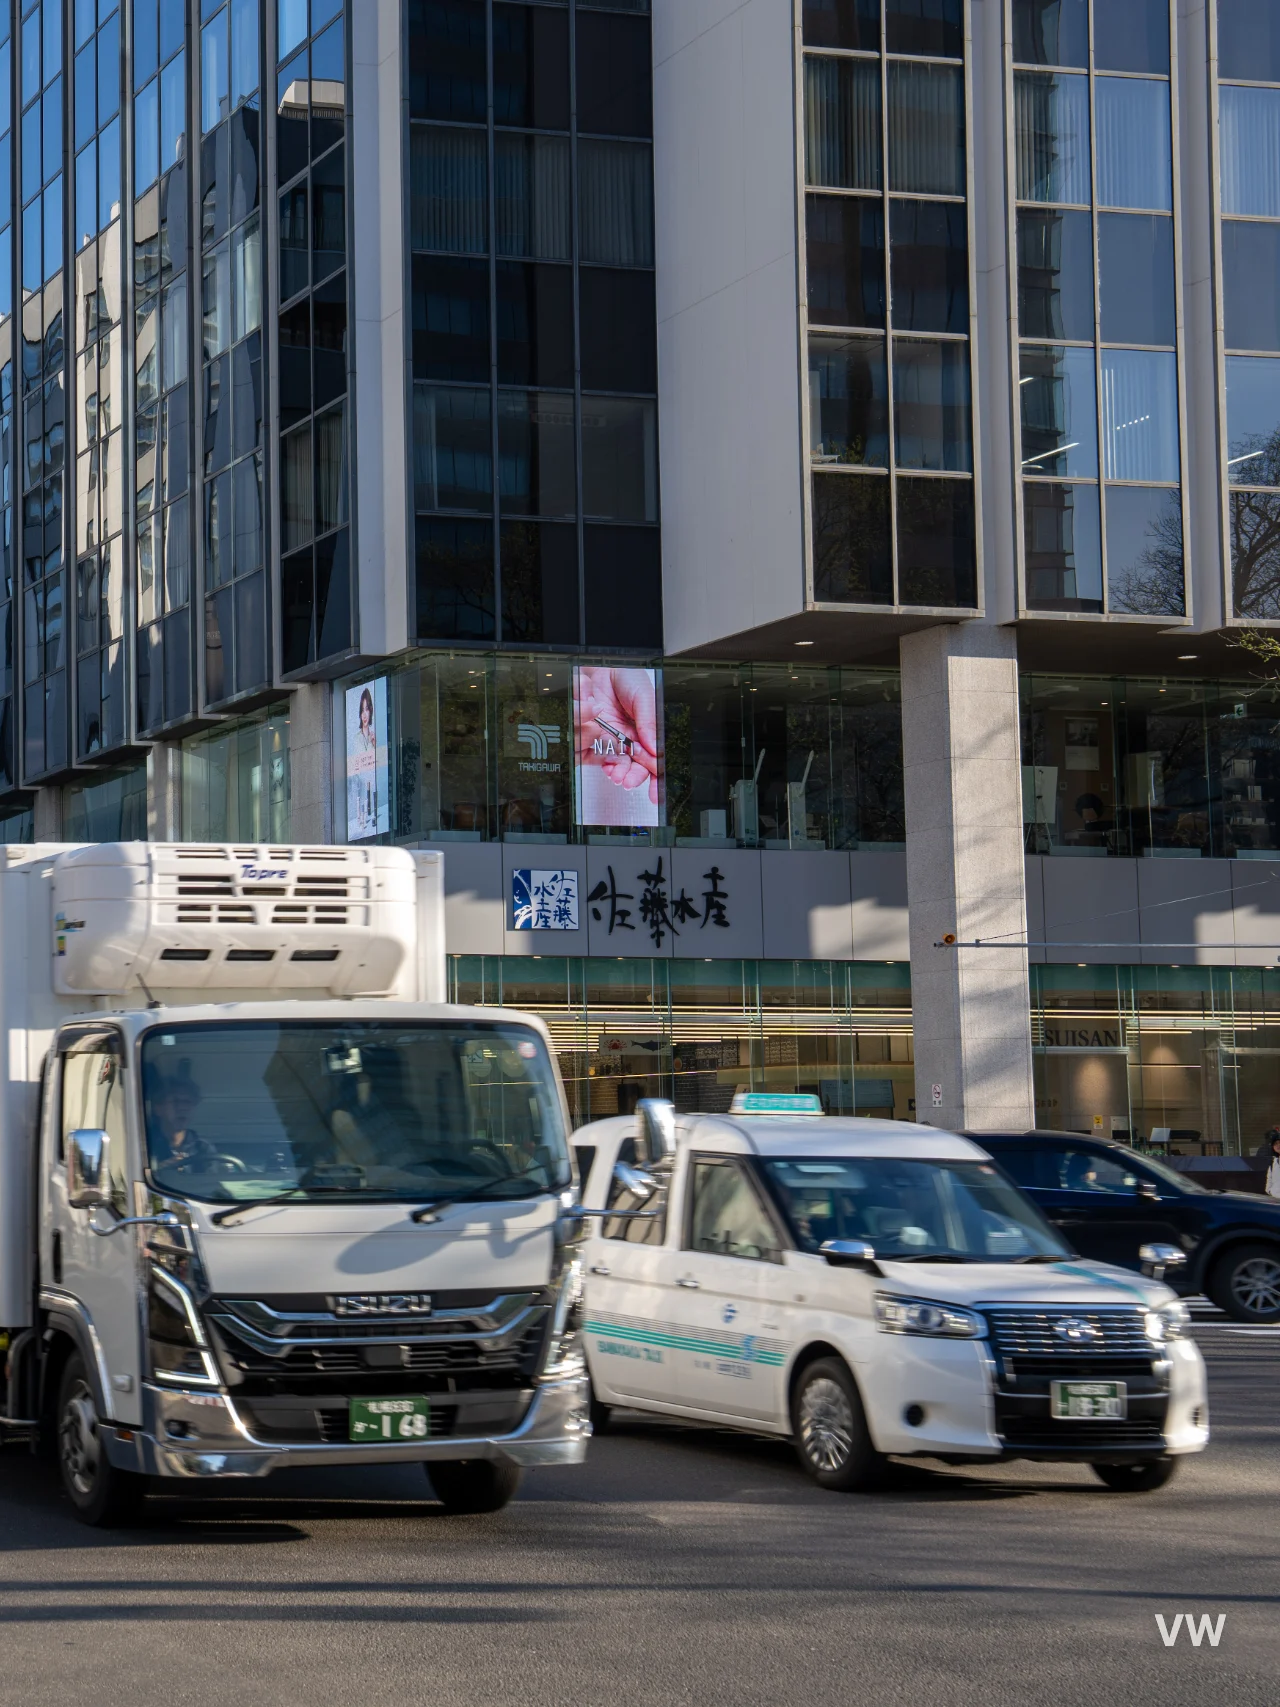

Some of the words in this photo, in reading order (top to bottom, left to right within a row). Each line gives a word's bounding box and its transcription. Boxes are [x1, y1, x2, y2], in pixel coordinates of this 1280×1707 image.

[518, 762, 561, 773] TAKIGAWA
[240, 865, 289, 881] Topre
[587, 856, 731, 948] 佐藤水産
[1044, 1029, 1119, 1047] SUISAN
[333, 1294, 432, 1316] ISUZU
